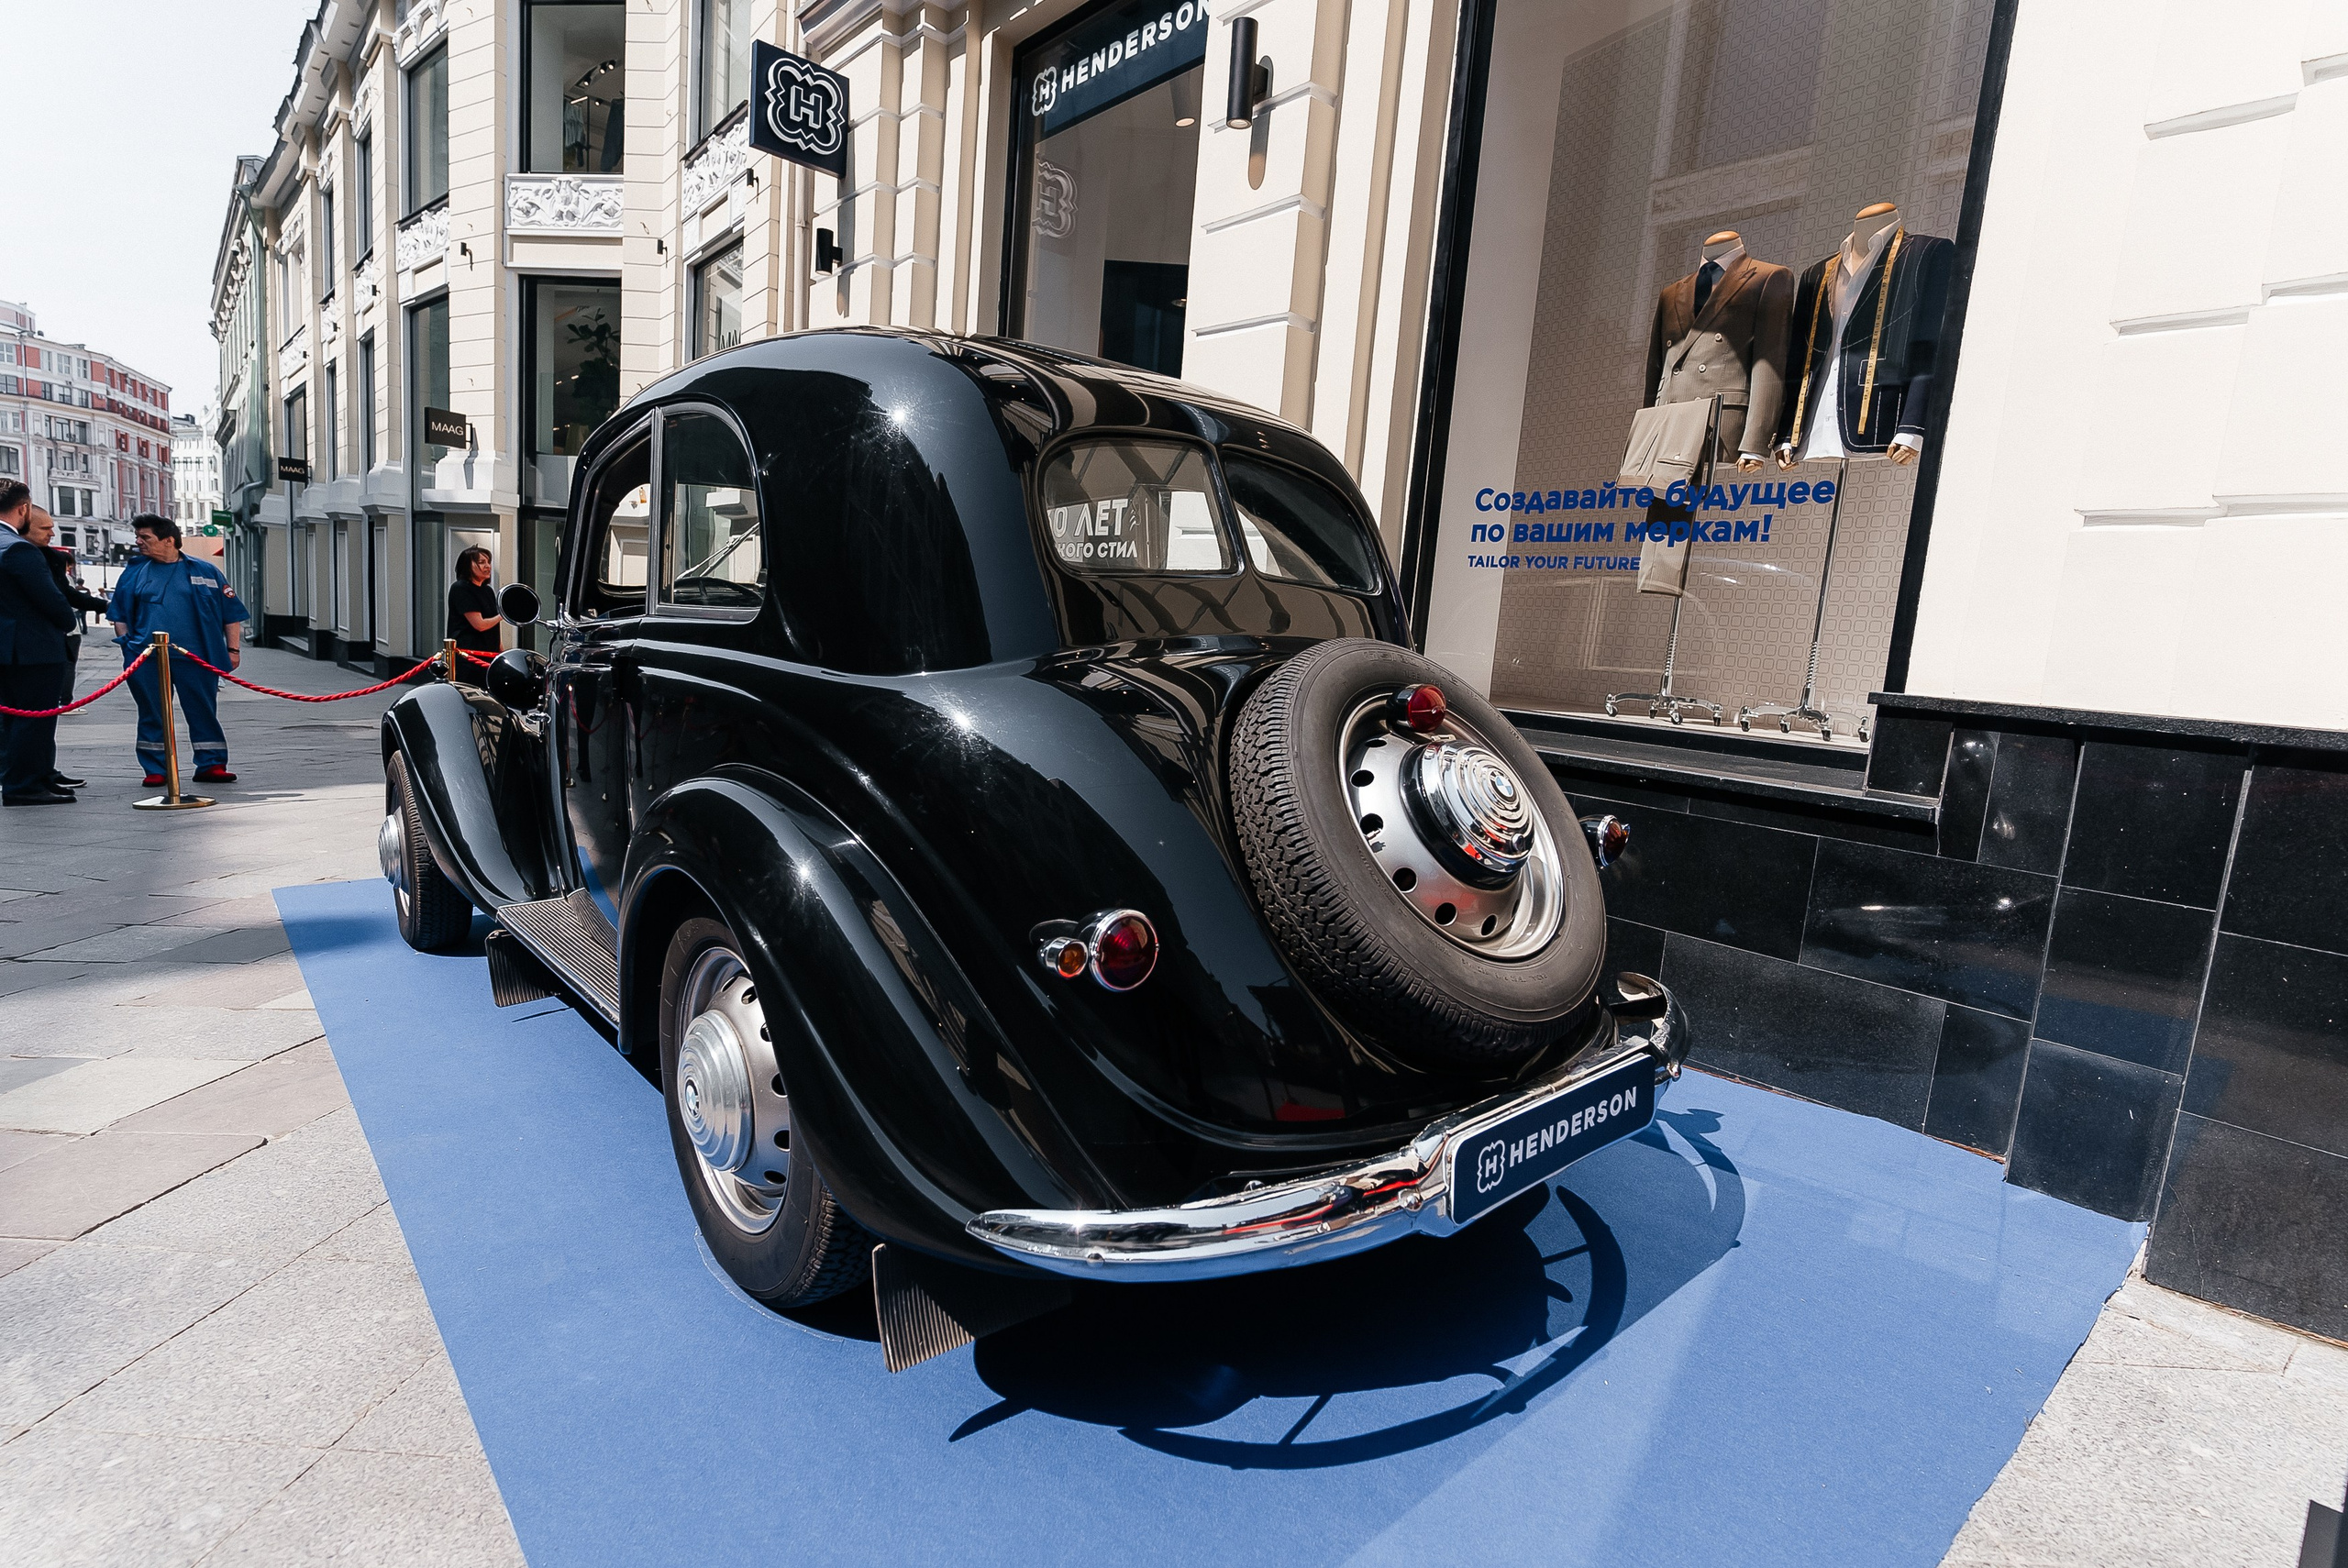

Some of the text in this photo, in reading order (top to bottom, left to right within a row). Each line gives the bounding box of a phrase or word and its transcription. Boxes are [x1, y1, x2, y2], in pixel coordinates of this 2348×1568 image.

[1060, 0, 1211, 94] HENDERSON
[431, 421, 463, 436] MAAG
[280, 465, 305, 474] MAAG
[1475, 479, 1835, 514] Создавайте будущее
[1074, 498, 1128, 536] ЛЕТ
[1470, 514, 1773, 548] по вашим меркам!
[1468, 555, 1642, 571] TAILOR YOUR FUTURE
[1509, 1086, 1638, 1168] HENDERSON
